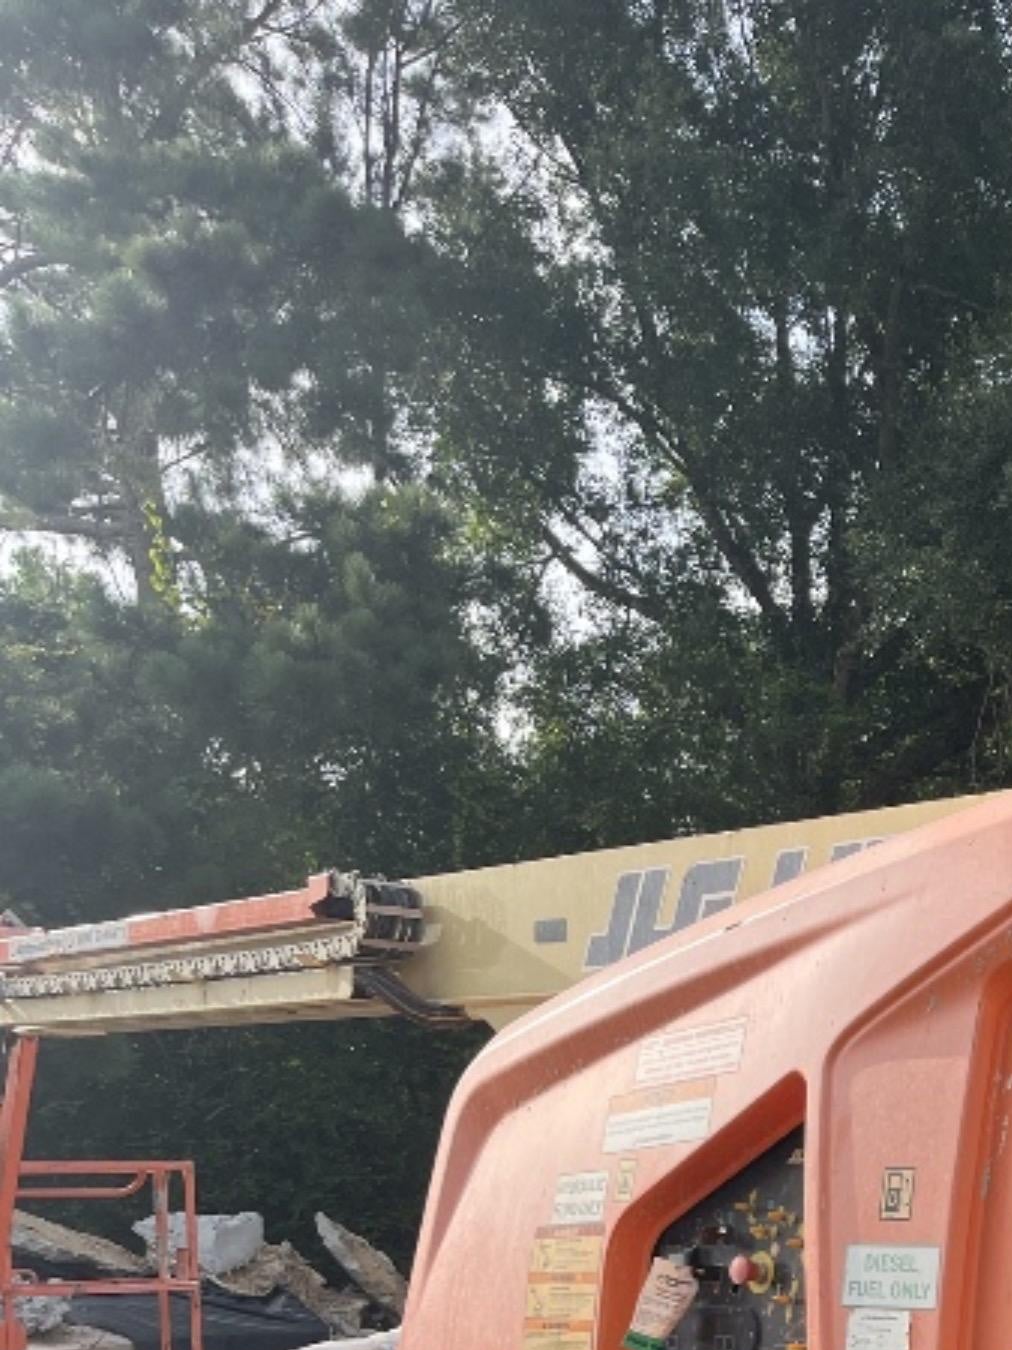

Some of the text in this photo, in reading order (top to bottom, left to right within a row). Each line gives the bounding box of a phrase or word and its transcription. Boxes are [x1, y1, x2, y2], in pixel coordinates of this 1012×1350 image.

[863, 1253, 920, 1273] DIESEL
[848, 1280, 931, 1300] FUEL ONLY
